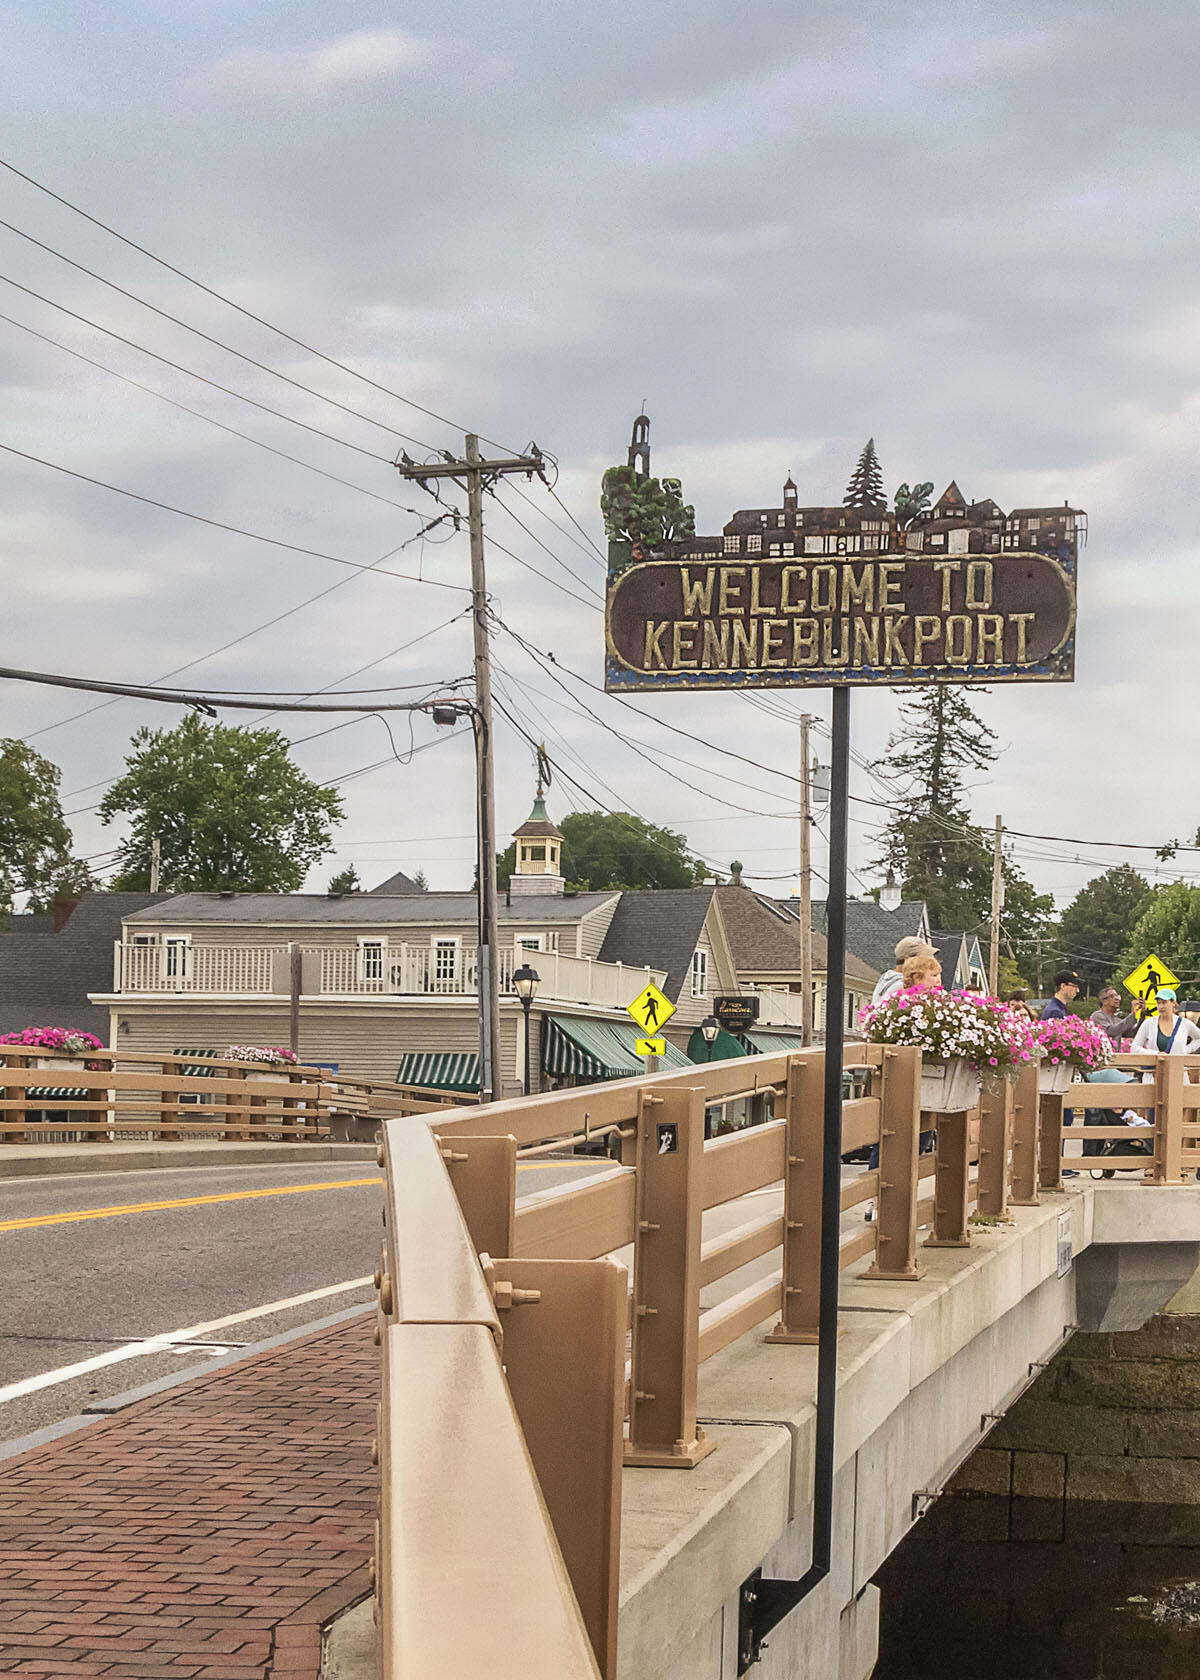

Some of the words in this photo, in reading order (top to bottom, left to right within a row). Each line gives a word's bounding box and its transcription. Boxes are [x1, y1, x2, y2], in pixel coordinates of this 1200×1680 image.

[680, 563, 905, 616] WELCOME
[934, 561, 993, 611] TO
[642, 612, 1036, 670] KENNEBUNKPORT
